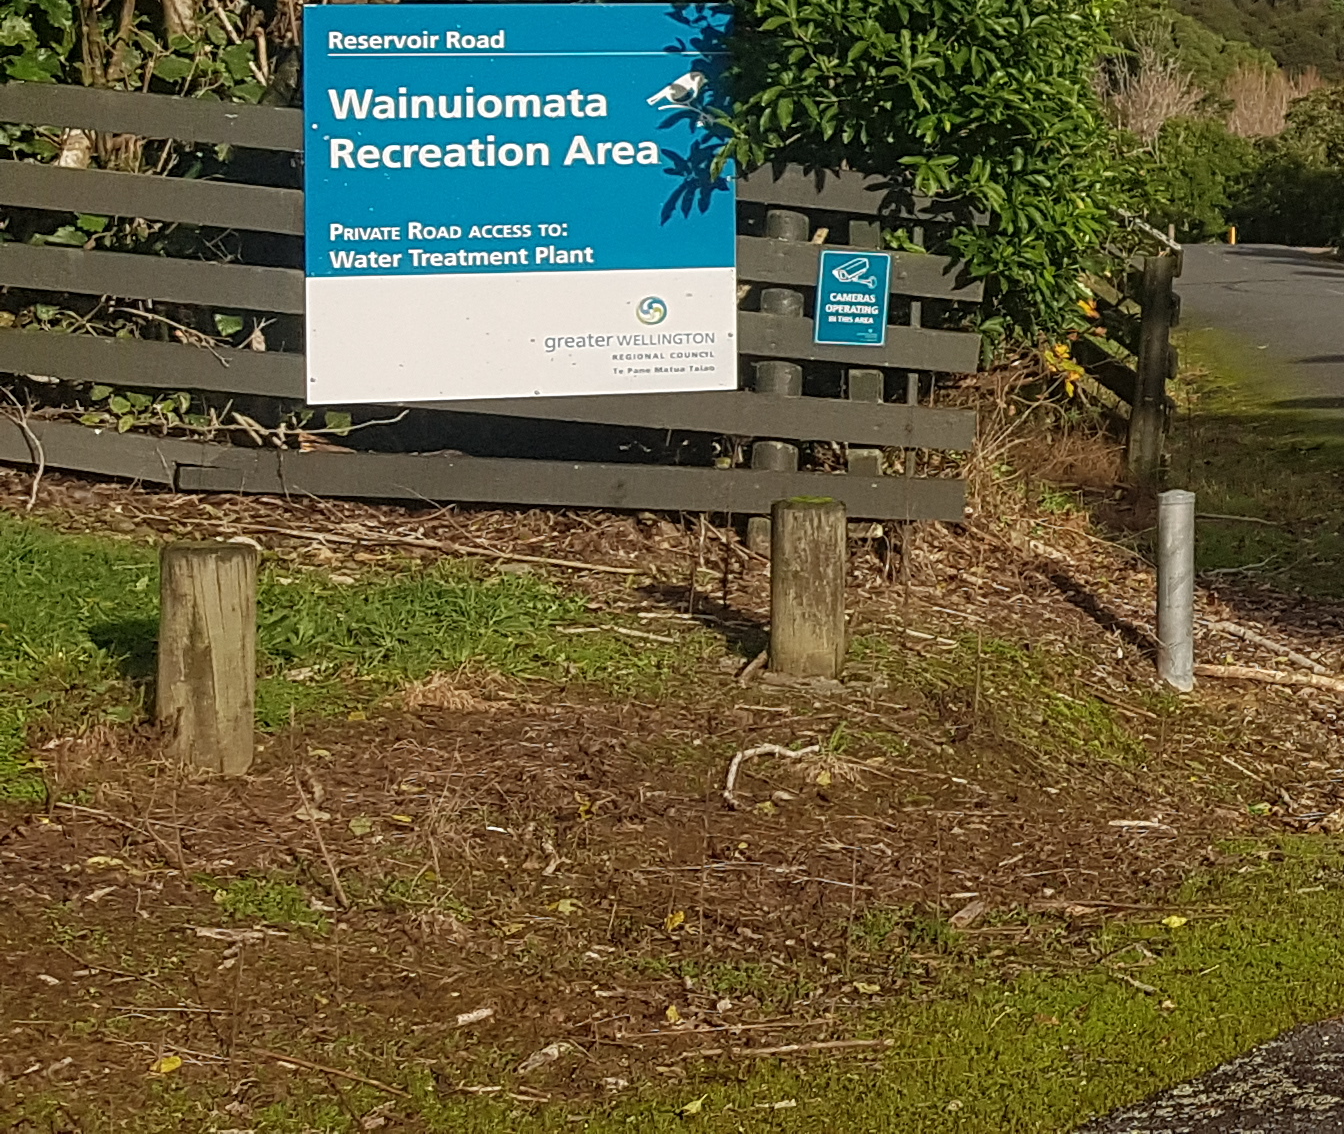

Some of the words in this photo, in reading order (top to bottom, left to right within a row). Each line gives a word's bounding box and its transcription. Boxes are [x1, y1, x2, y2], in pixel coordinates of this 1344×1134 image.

[328, 30, 440, 50] Reservoir
[445, 29, 505, 49] Road
[328, 86, 608, 120] Wainuiomata
[330, 134, 550, 169] Recreation
[563, 135, 660, 166] Area
[329, 223, 400, 241] PRIVATE
[408, 221, 461, 240] ROAD
[468, 224, 531, 239] ACCESS
[538, 222, 568, 237] TO:
[329, 250, 402, 269] Water
[408, 248, 528, 267] Treatment
[535, 245, 594, 265] Plant
[829, 292, 876, 303] CAMERAS
[825, 304, 879, 315] OPERATING
[828, 315, 837, 323] IN
[544, 333, 613, 353] greater
[616, 332, 716, 347] WELLINGTON
[612, 352, 665, 361] REGIONAL
[669, 351, 715, 359] COUNCIL
[613, 367, 623, 375] Te
[654, 366, 685, 374] Matua
